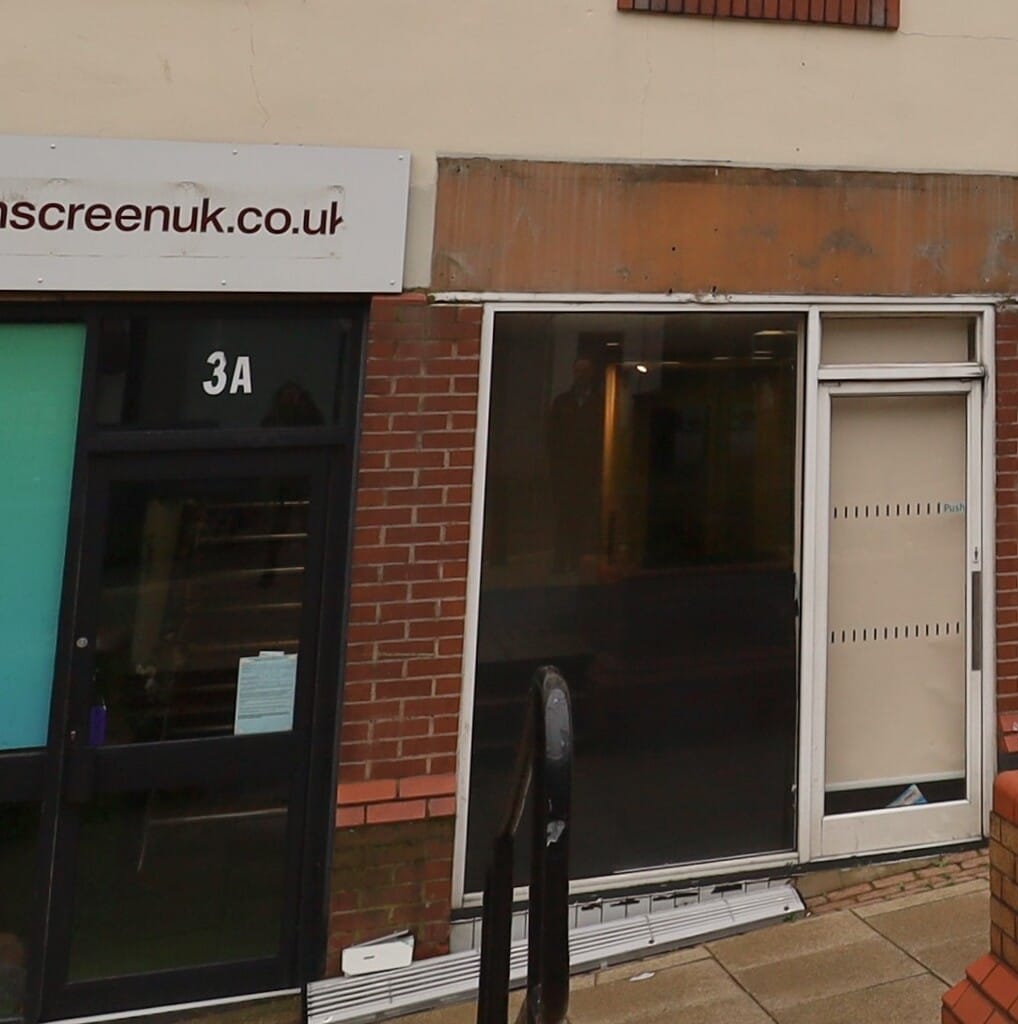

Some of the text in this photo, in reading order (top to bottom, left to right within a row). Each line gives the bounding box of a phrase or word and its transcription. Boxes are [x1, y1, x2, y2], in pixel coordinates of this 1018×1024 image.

[0, 198, 344, 236] screenuk.co.uk
[202, 350, 253, 395] 3A
[943, 503, 965, 513] Push
